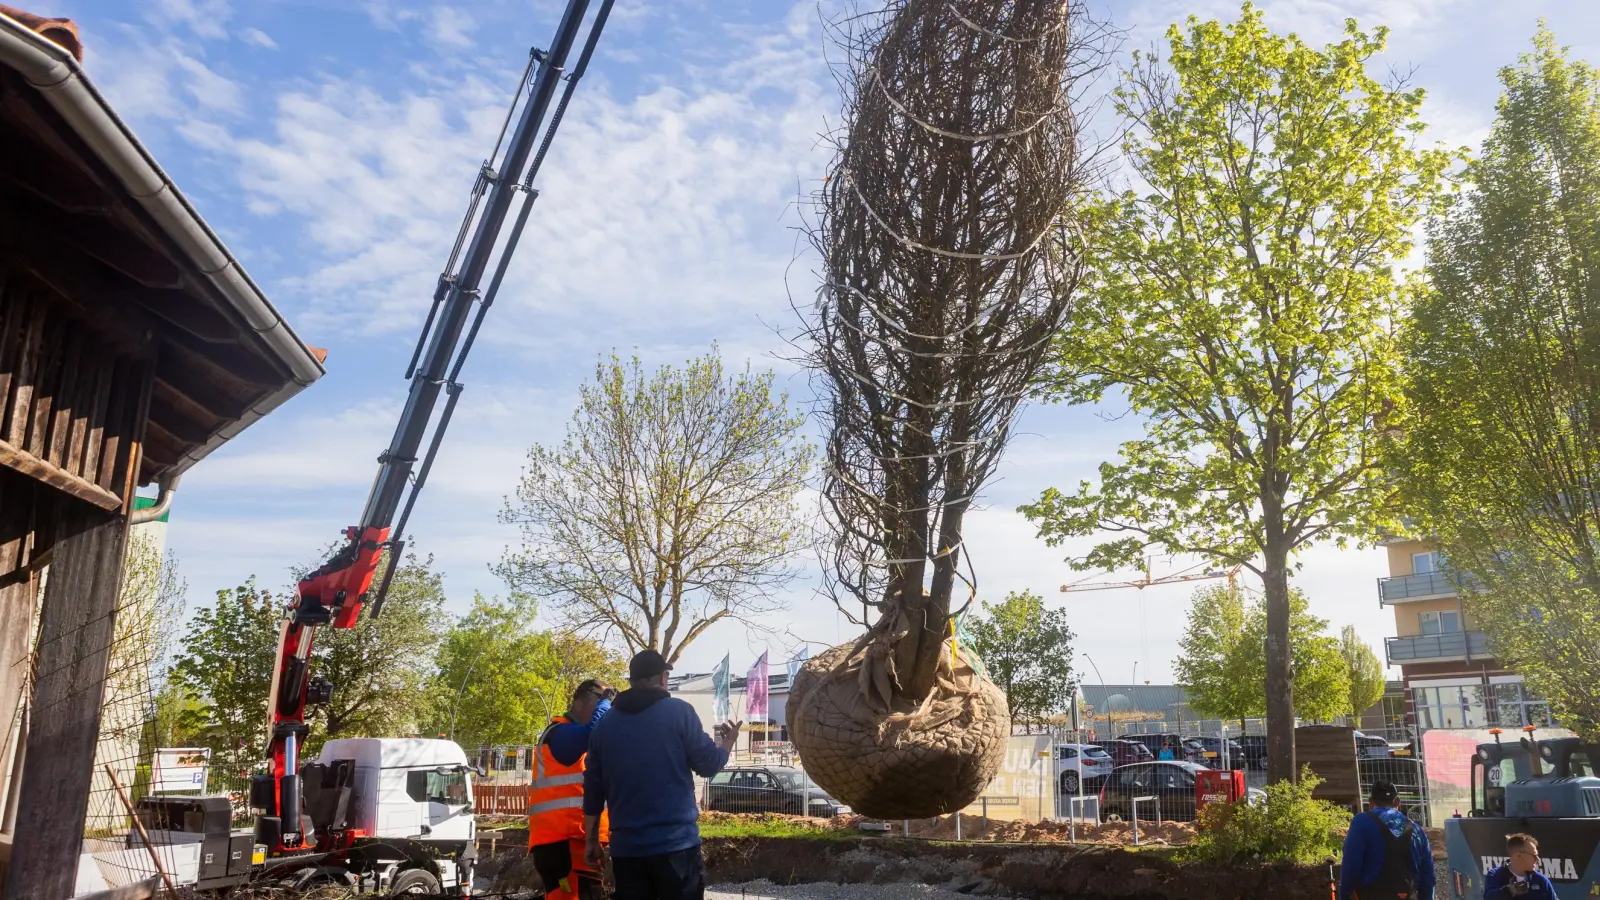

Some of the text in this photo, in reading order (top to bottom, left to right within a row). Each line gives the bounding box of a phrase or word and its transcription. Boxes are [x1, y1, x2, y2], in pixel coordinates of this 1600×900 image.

[194, 773, 202, 783] P
[1490, 769, 1500, 780] 20
[1480, 855, 1579, 880] HYMA
